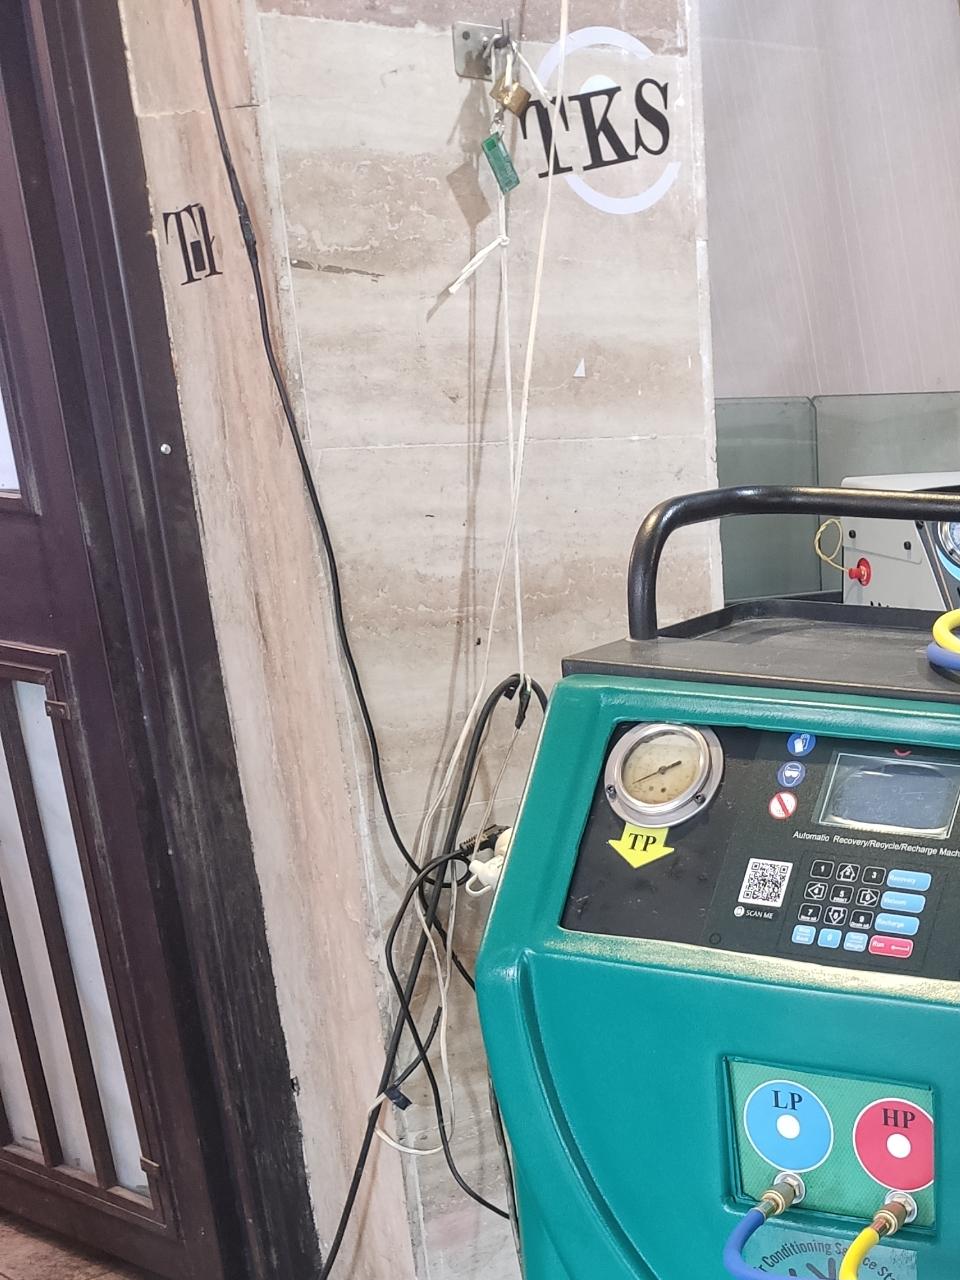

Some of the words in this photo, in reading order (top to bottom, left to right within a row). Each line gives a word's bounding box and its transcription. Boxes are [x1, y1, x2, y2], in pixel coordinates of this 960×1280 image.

[518, 78, 670, 179] TKS
[628, 832, 657, 852] TP
[745, 909, 763, 918] SCAN
[763, 912, 774, 920] ME
[771, 1089, 803, 1110] LP
[882, 1108, 916, 1129] HP
[762, 1240, 832, 1269] Conditioning
